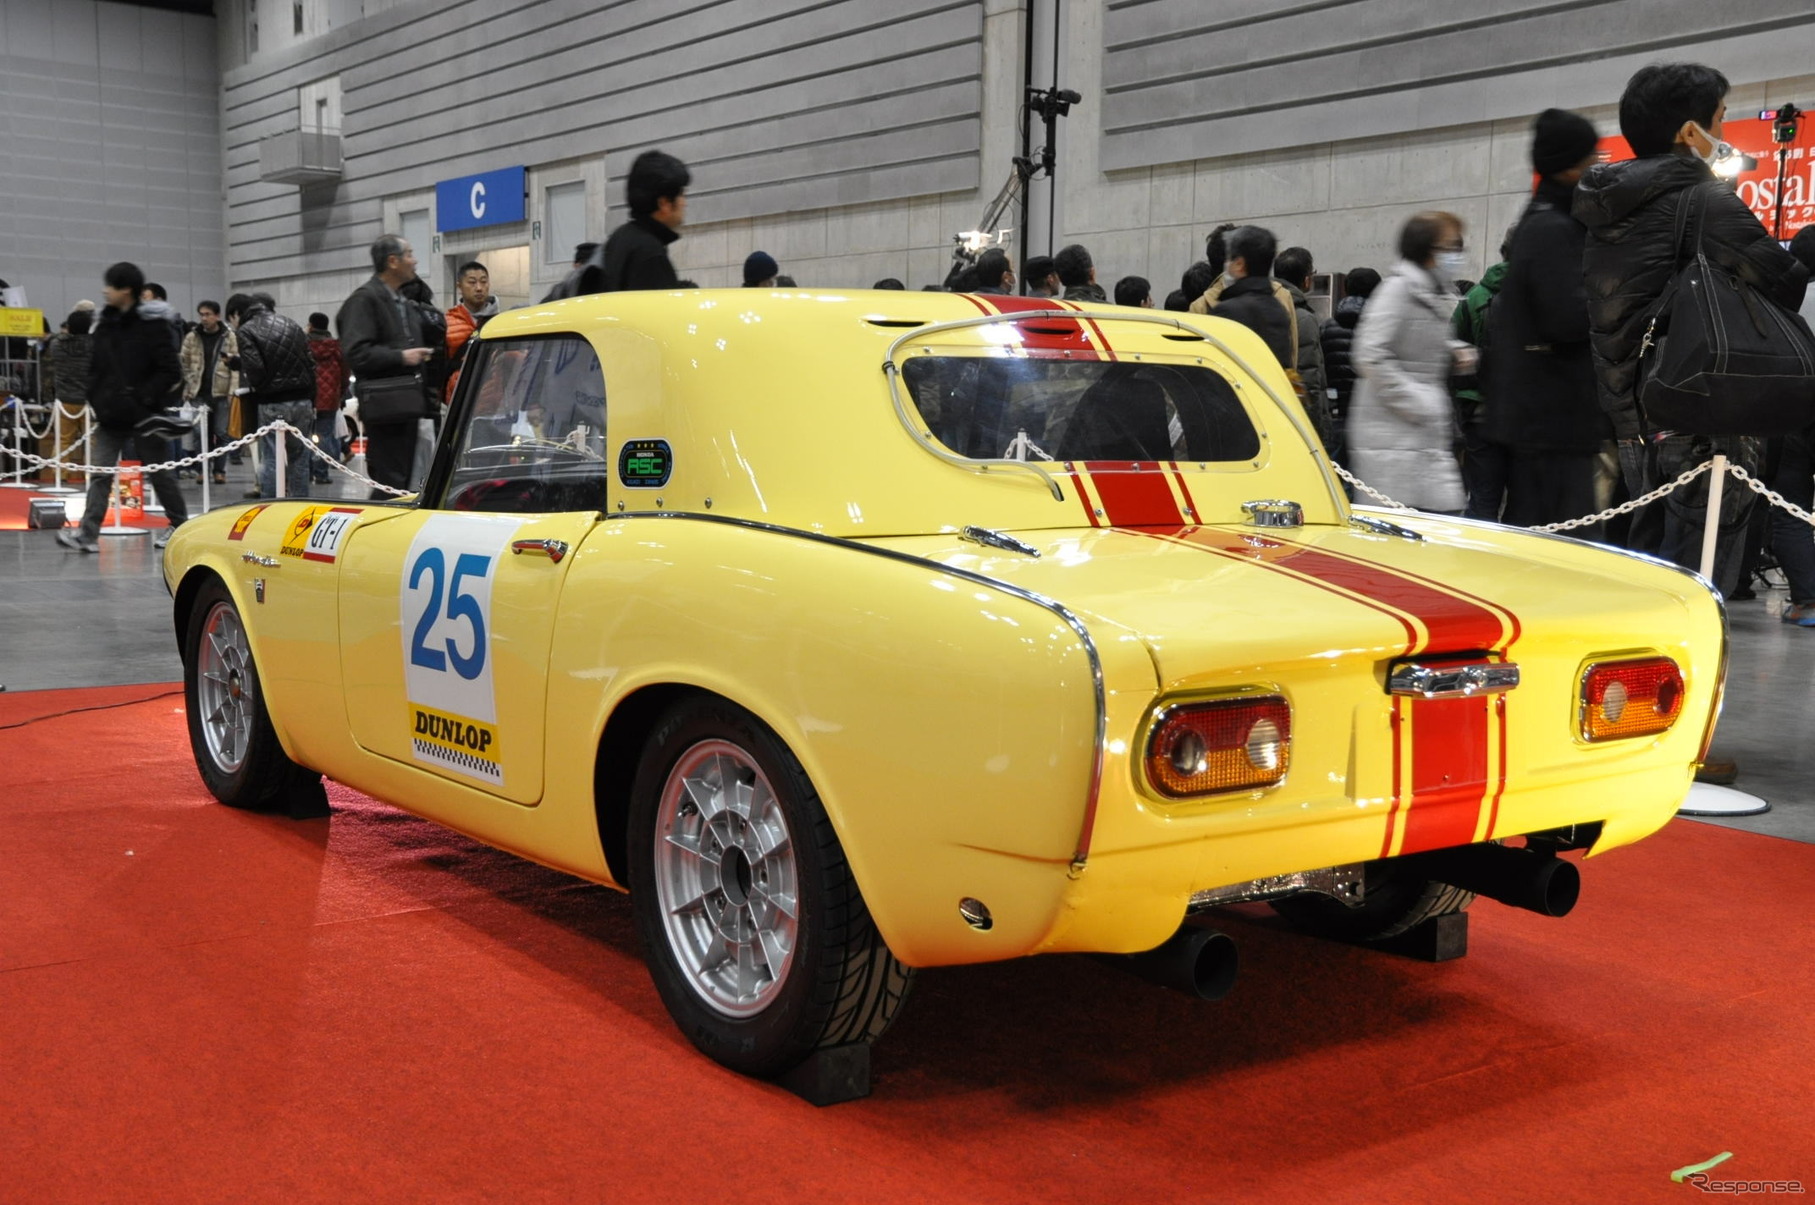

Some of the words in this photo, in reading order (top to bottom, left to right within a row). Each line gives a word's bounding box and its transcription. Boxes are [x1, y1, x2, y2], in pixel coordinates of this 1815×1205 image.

[470, 181, 486, 219] C
[627, 458, 663, 474] ASC
[280, 546, 304, 557] DUNLOP
[409, 547, 491, 680] 25
[415, 711, 492, 752] DUNLOP
